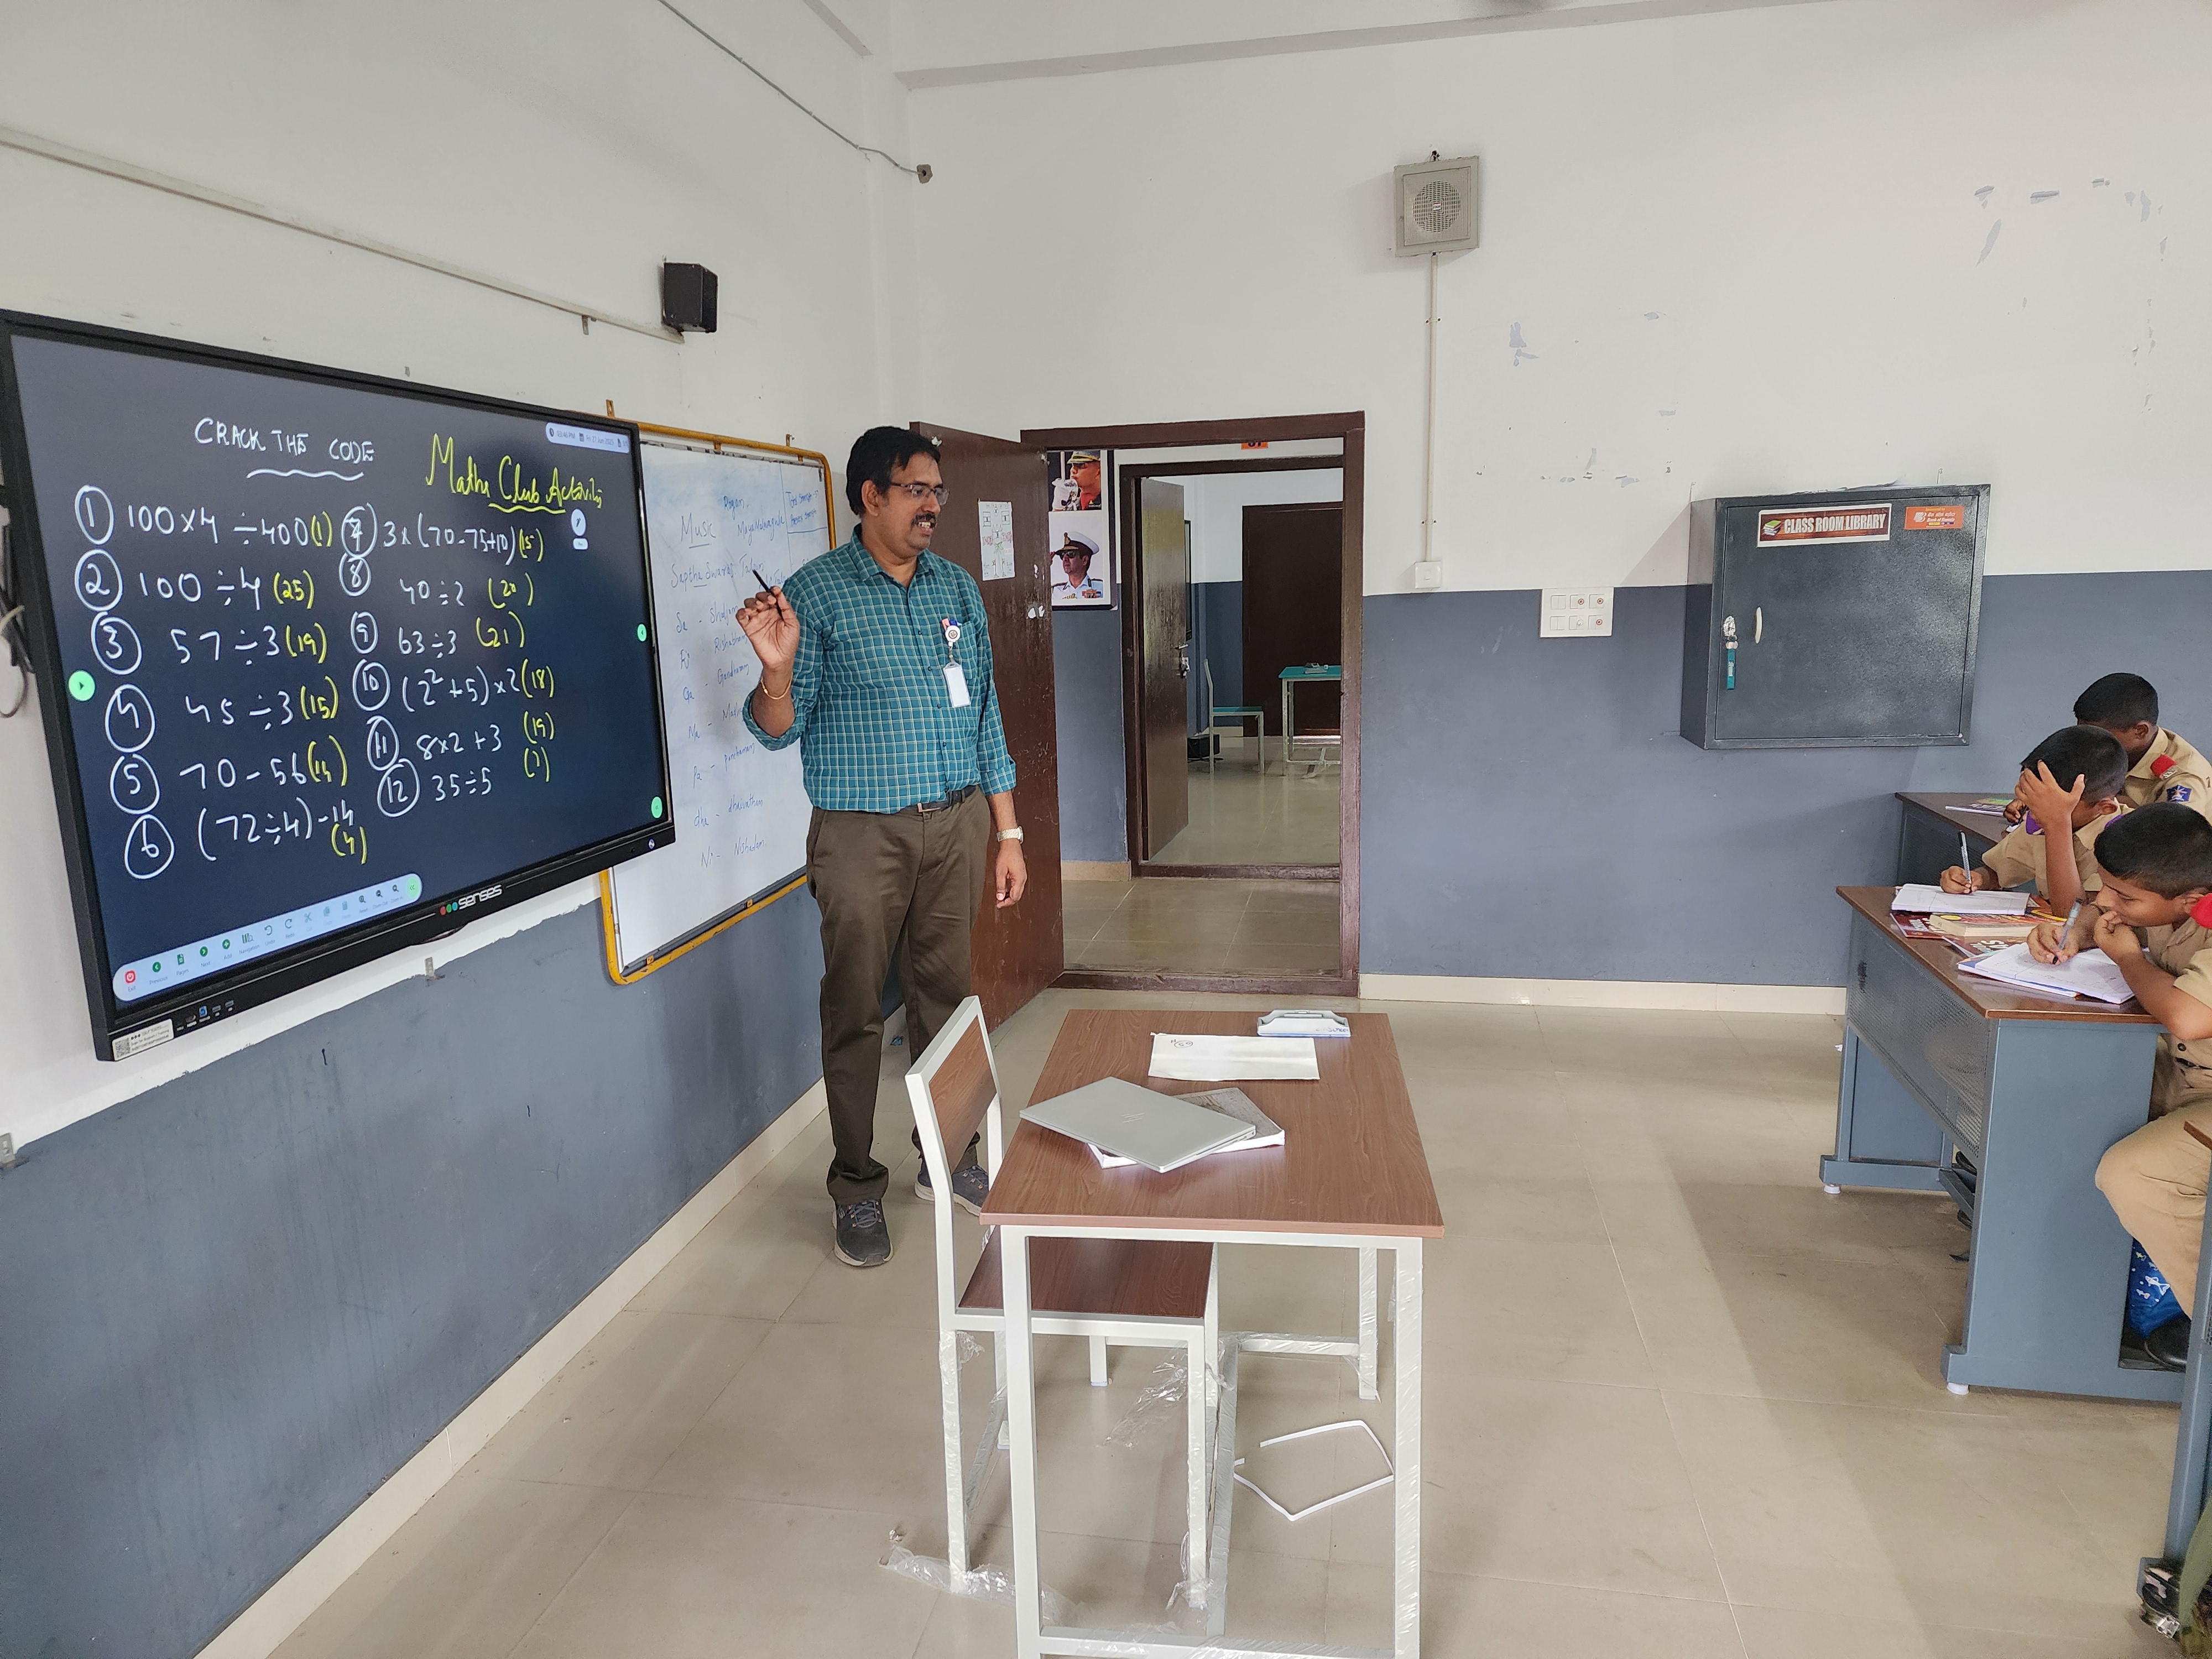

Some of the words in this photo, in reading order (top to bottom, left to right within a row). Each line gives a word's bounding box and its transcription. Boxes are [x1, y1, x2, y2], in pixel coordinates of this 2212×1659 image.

[195, 418, 265, 451] CRACK
[271, 429, 309, 455] THE
[330, 439, 374, 462] CODE
[499, 455, 540, 503] Club
[681, 512, 716, 544] Music
[1784, 518, 1814, 534] CLASS
[1815, 516, 1844, 532] ROOM
[1845, 514, 1886, 530] LIBRARY
[458, 885, 502, 910] senses
[239, 945, 260, 954] Navigation
[149, 976, 168, 985] Previous
